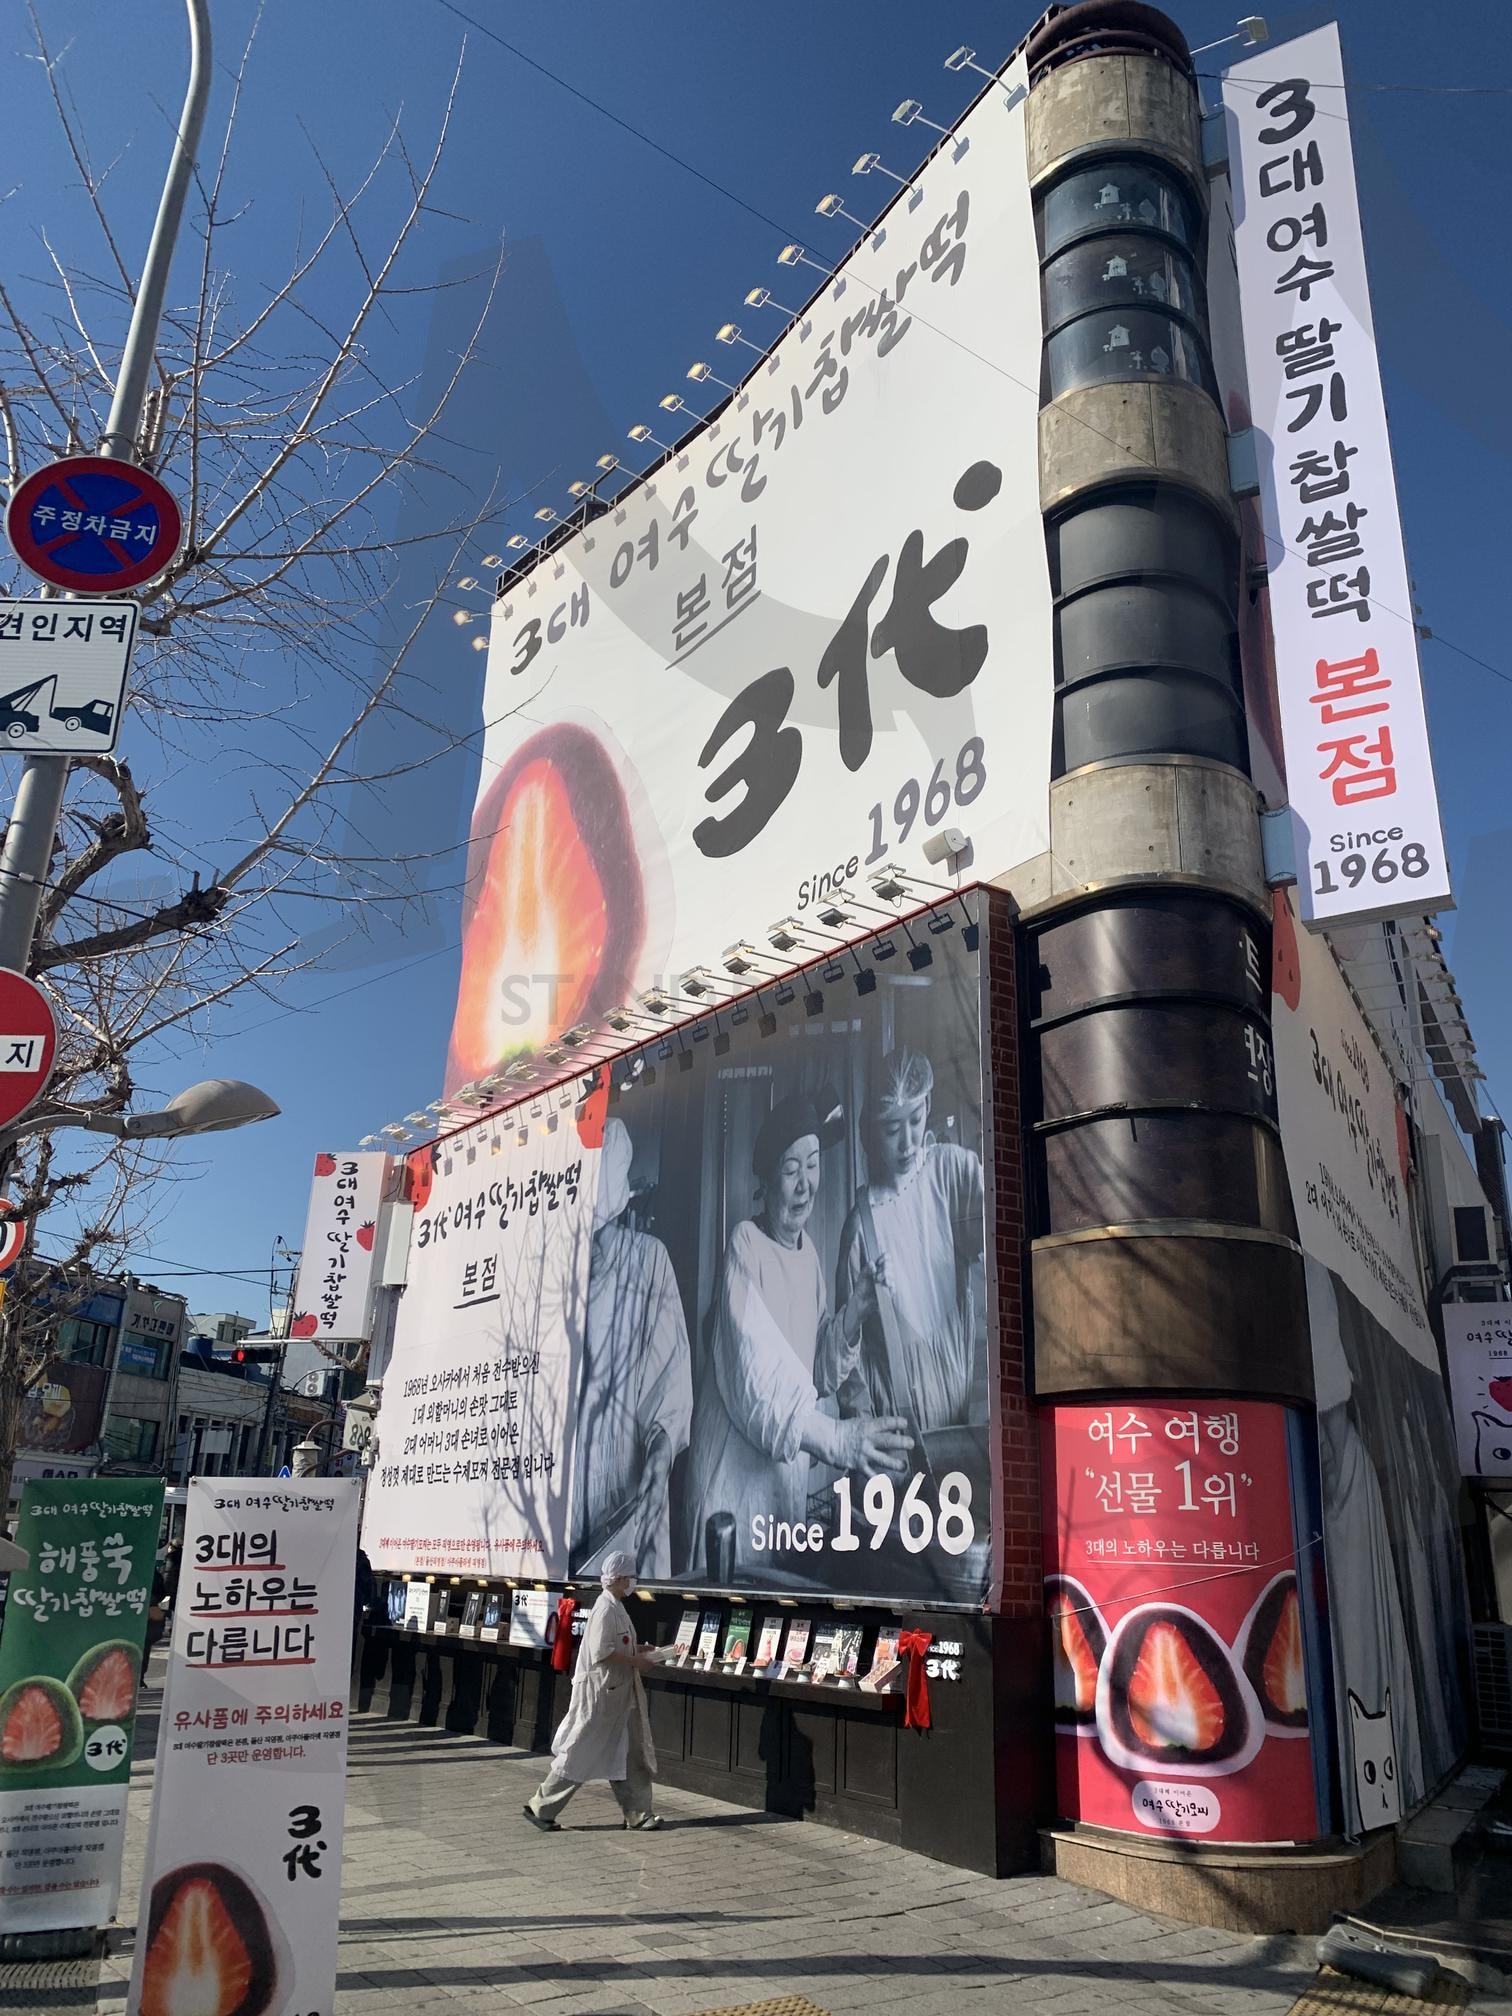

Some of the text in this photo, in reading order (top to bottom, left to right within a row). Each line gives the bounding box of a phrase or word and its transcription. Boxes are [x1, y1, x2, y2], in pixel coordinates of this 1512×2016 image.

[33, 504, 157, 545] 주정차금지
[672, 525, 757, 652] 본점
[511, 580, 590, 675] 3대
[1309, 647, 1397, 806] 본점
[865, 736, 987, 866] 1968
[1330, 826, 1404, 853] Since
[1313, 842, 1430, 895] 1968
[462, 1253, 498, 1296] 본점
[472, 1361, 490, 1386] 처음
[426, 1397, 467, 1422] 외할머니의
[470, 1394, 488, 1418] 손맛
[489, 1390, 518, 1413] 그대로
[403, 1433, 418, 1455] 2대
[420, 1431, 443, 1454] 어머니
[445, 1429, 459, 1451] 3대
[491, 1421, 519, 1447] 이어온
[1088, 1411, 1240, 1456] 여수 여행
[427, 1463, 451, 1484] 만드는
[491, 1455, 520, 1480] 전문점
[523, 1452, 555, 1479] 입니다
[751, 1471, 975, 1556] Since 1968
[38, 1532, 133, 1585] 해풍쑥
[196, 1529, 278, 1566] 3대의
[1086, 1539, 1260, 1561] 3대의 노하우는 다릅니다
[13, 1586, 147, 1622] 딸기찹쌀떡
[190, 1576, 318, 1612] 노하우는
[187, 1623, 314, 1665] 다릅니다
[173, 1701, 343, 1731] 유사품에 주의하세요
[207, 1752, 217, 1766] 단
